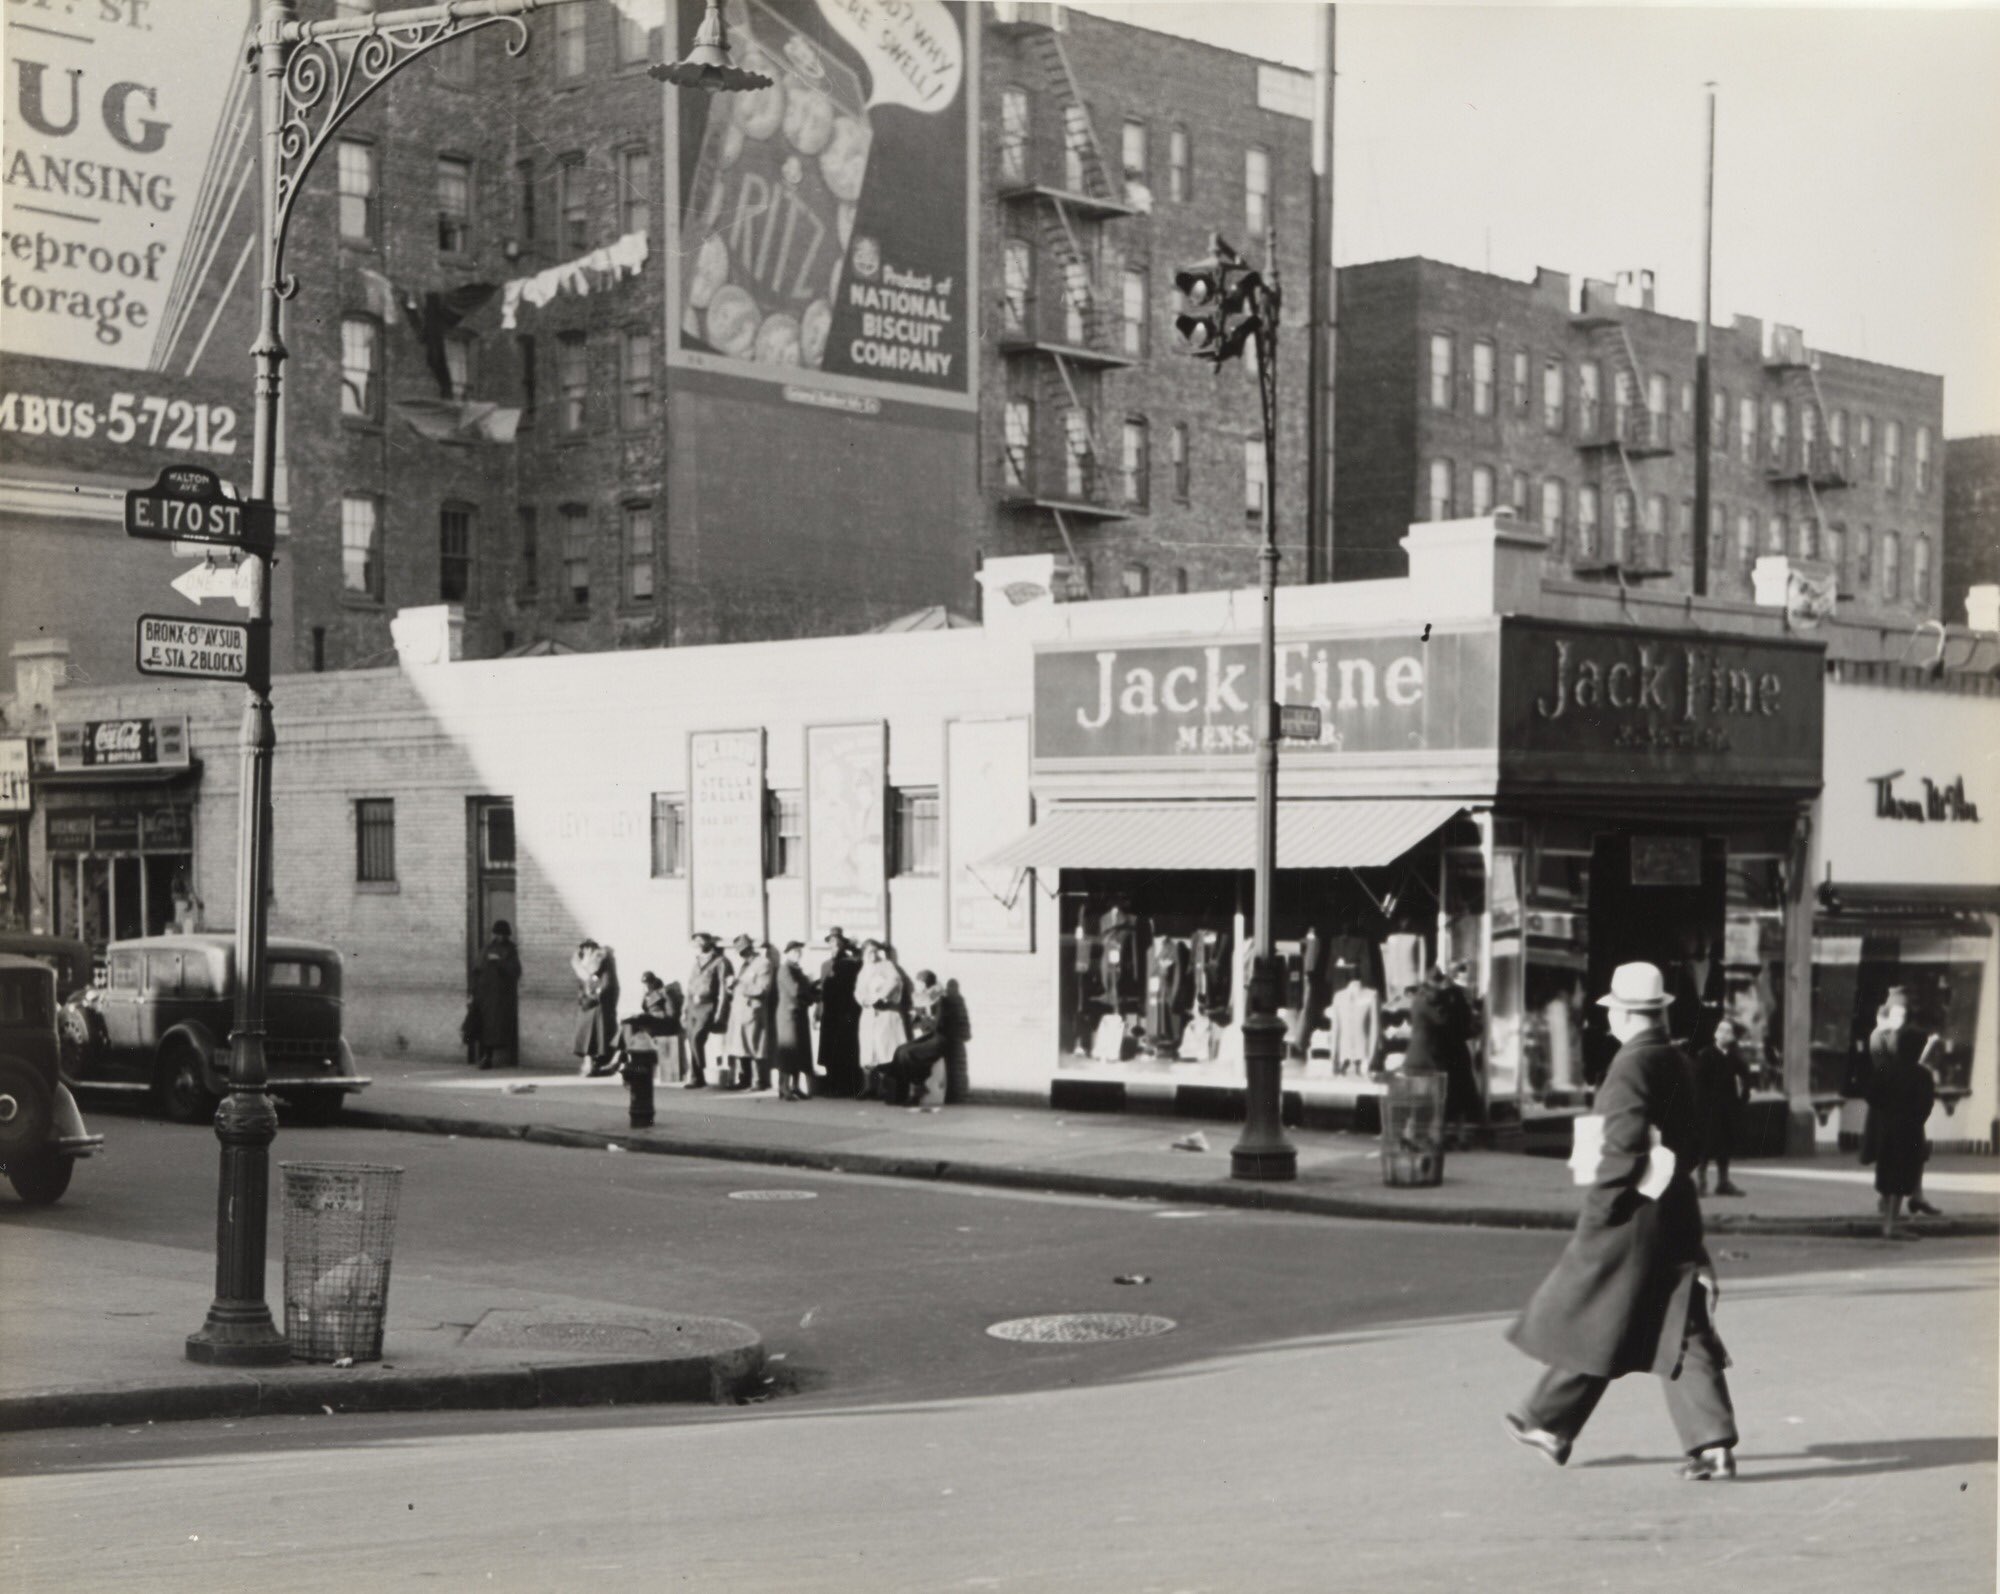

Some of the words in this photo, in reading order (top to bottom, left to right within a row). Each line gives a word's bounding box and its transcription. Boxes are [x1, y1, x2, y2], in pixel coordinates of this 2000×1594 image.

[3, 58, 172, 154] UG
[3, 147, 176, 213] ANSING
[730, 171, 825, 299] RITZ
[883, 264, 933, 292] Product
[936, 276, 953, 295] of
[850, 284, 952, 321] NATIONAL
[862, 312, 943, 347] BISCUIT
[850, 339, 953, 376] COMPANY
[169, 472, 209, 484] WALTON
[135, 498, 154, 527] E.
[162, 499, 203, 531] 170
[209, 505, 241, 535] ST.
[189, 650, 198, 670] 2
[200, 651, 243, 673] BLOCKS
[1537, 640, 1666, 719] Jack
[1684, 648, 1781, 720] Fine
[1076, 647, 1248, 729] Jack
[1274, 642, 1424, 710] Fine
